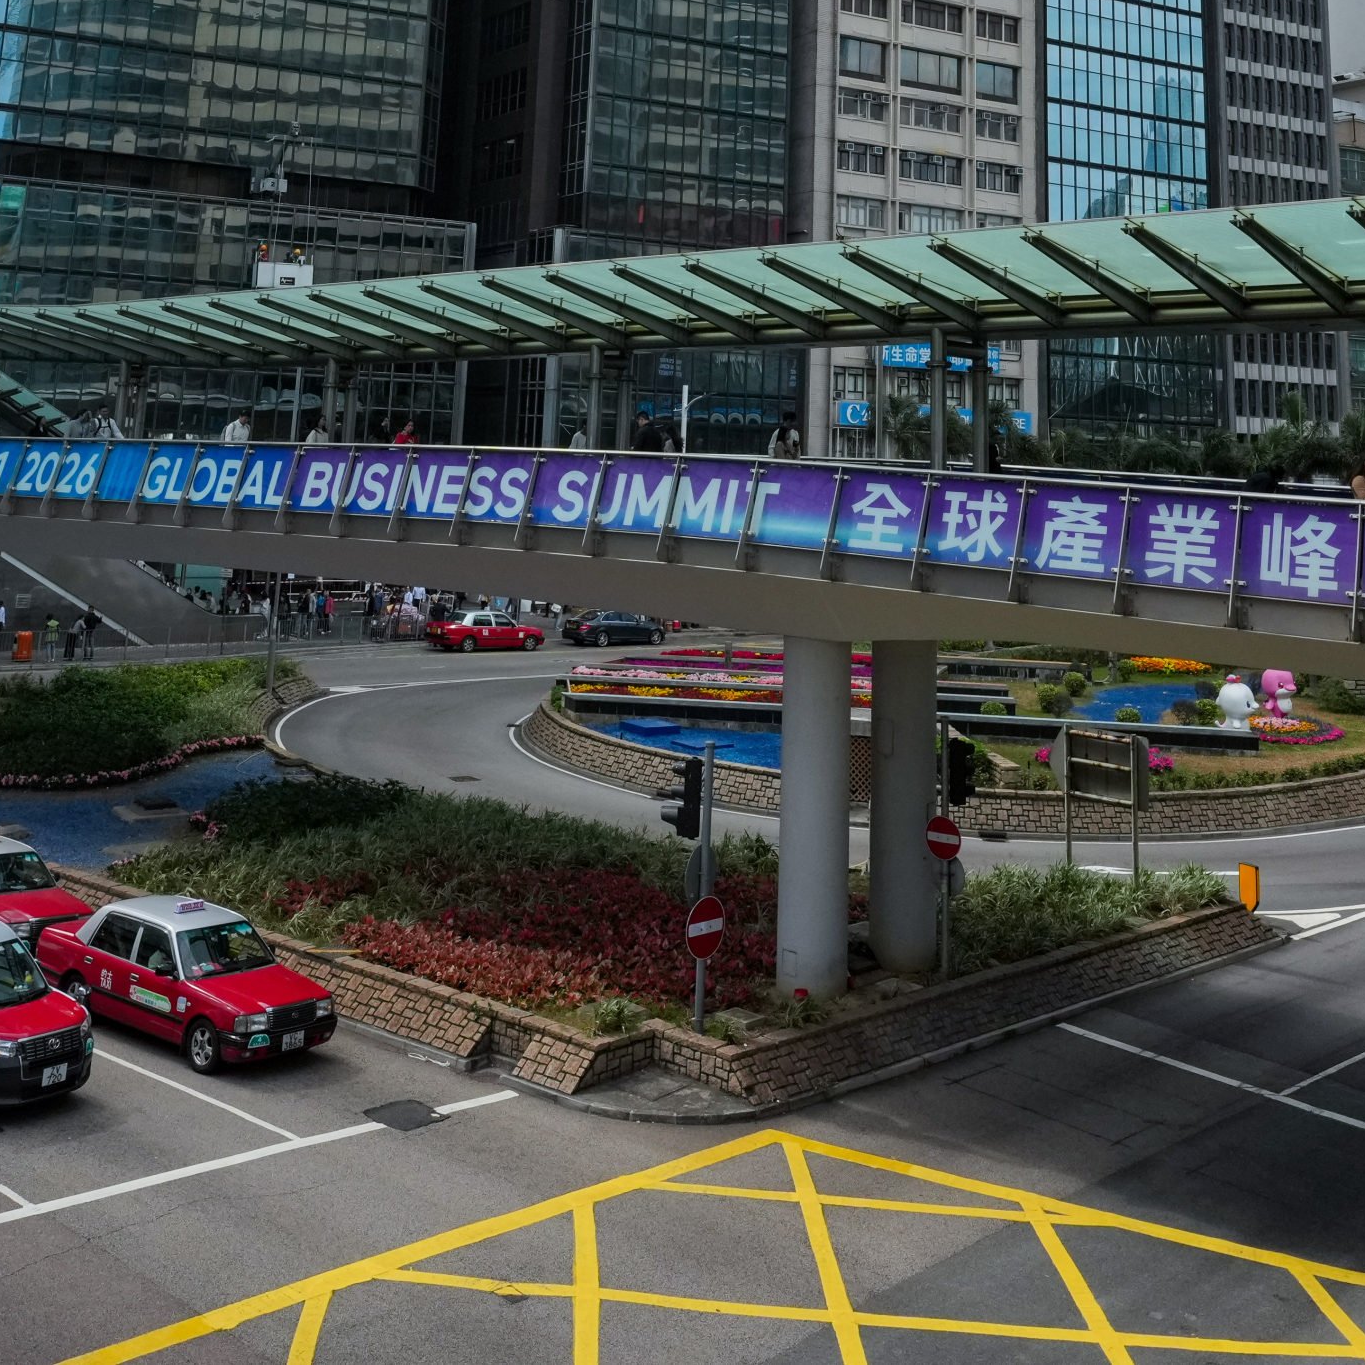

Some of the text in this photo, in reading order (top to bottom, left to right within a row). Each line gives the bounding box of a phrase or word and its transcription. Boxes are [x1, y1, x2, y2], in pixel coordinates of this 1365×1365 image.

[142, 455, 782, 534] GLOBAL BUSINESS SUMMIT
[100, 977, 112, 990] TAXI
